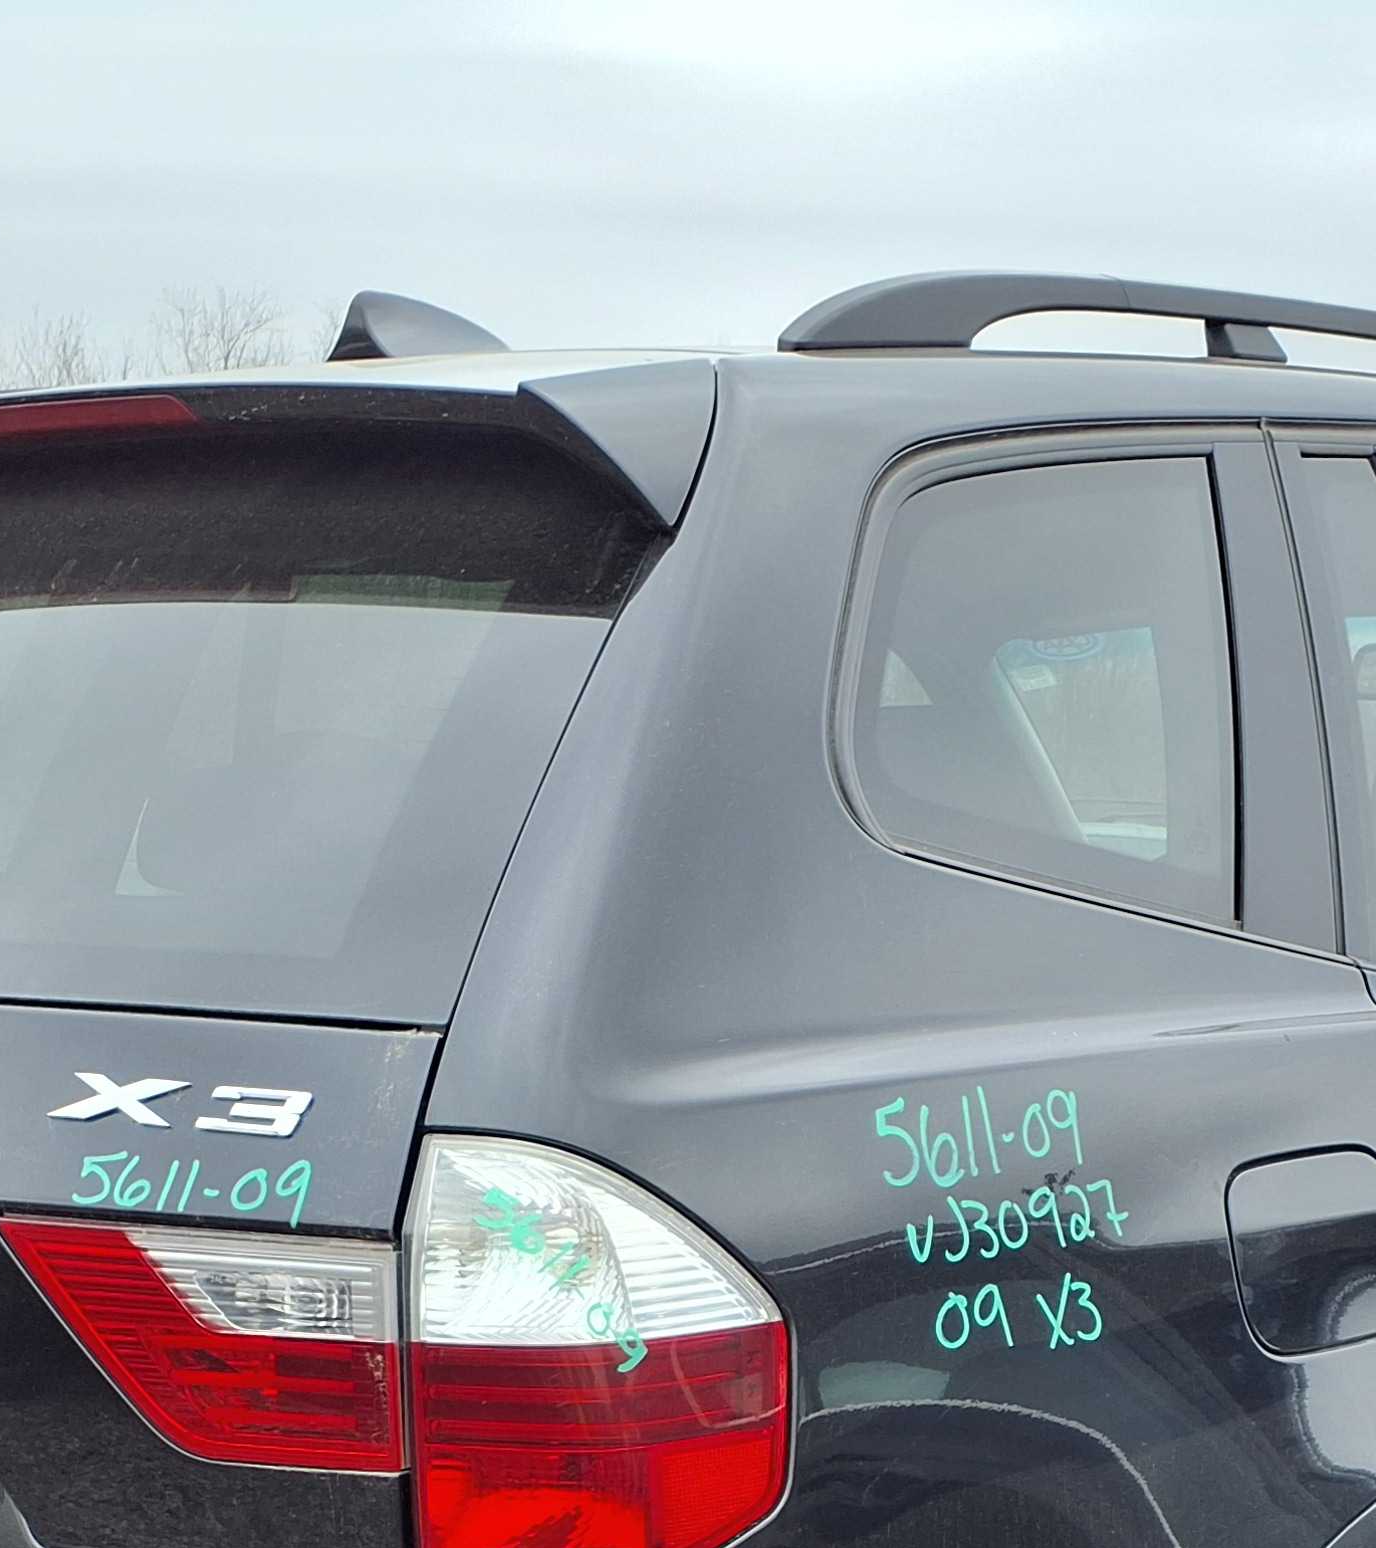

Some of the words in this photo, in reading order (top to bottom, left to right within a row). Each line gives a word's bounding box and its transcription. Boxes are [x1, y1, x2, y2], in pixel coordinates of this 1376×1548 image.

[875, 1086, 1083, 1187] 5611-09
[72, 1150, 312, 1229] 5611-09
[935, 1283, 1015, 1349] 09
[1036, 1271, 1103, 1350] X3
